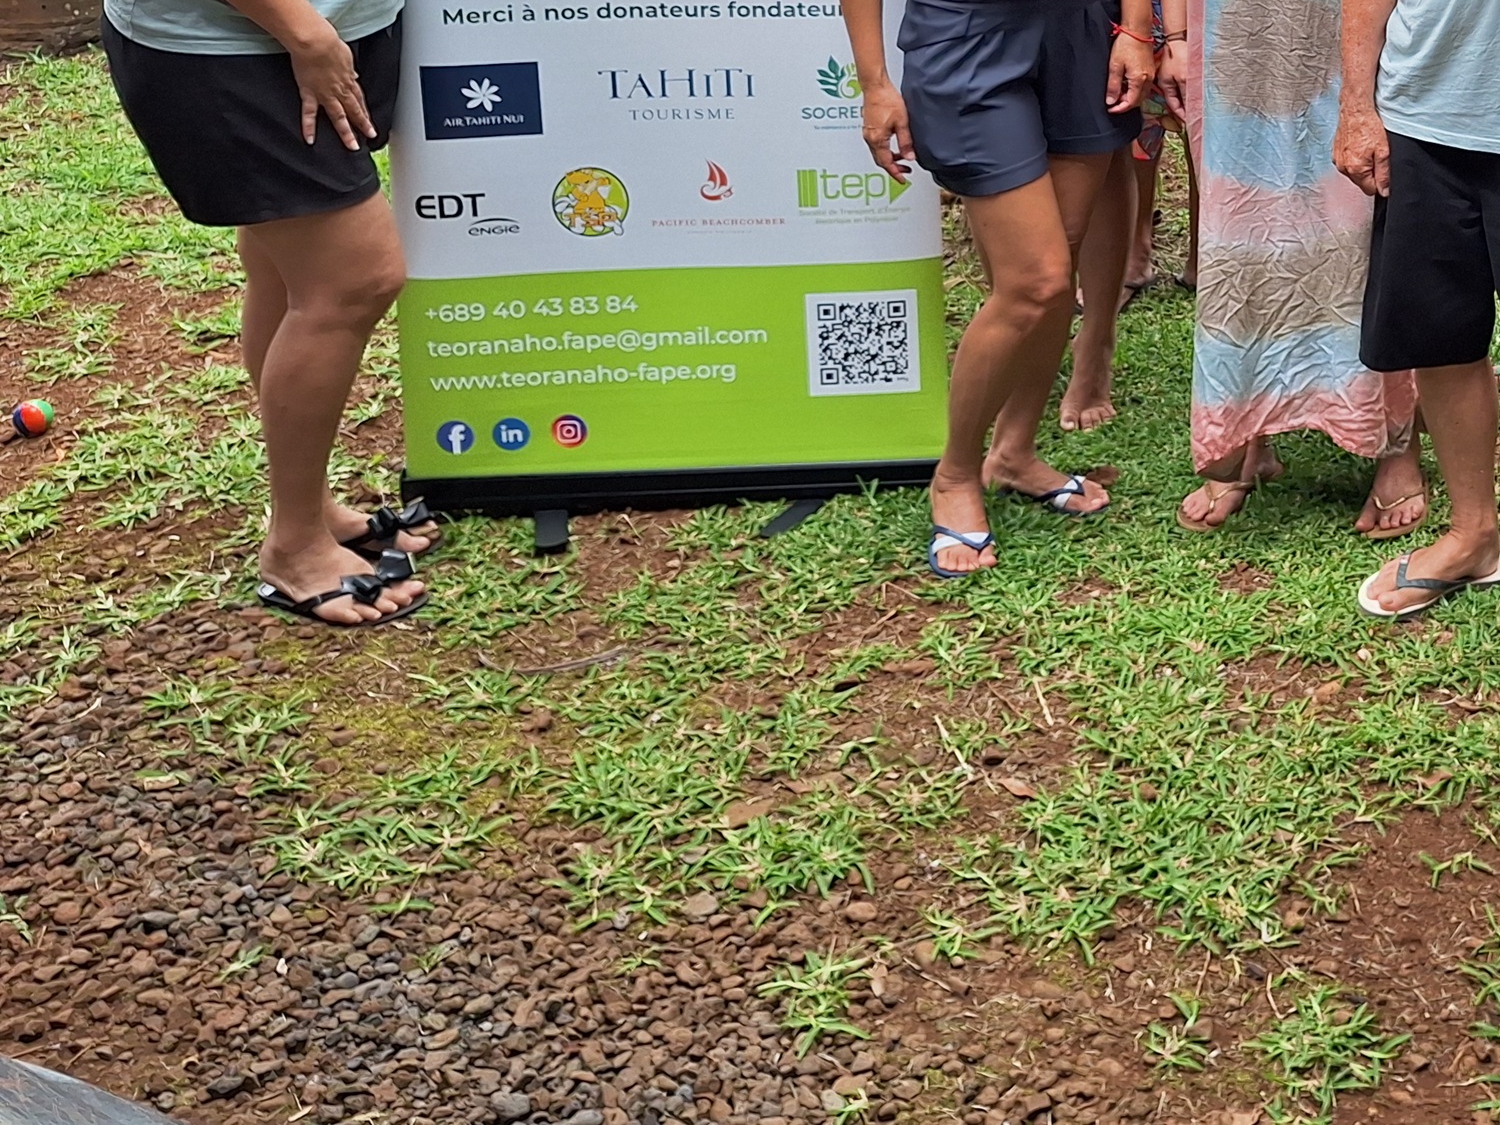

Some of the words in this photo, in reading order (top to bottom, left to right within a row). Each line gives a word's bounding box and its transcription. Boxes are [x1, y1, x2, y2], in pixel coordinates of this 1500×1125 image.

[442, 3, 514, 25] Merci
[521, 3, 536, 21] à
[544, 6, 589, 21] nos
[596, 1, 721, 20] donateurs
[597, 68, 756, 99] TAHITI
[443, 116, 464, 127] AIR
[464, 115, 501, 126] TAHITI
[503, 114, 525, 123] NUI
[628, 108, 736, 121] TOURISME
[415, 193, 486, 220] EDT
[651, 219, 698, 227] PACIFIC
[701, 218, 786, 226] BEACHCOMBER
[425, 302, 486, 323] +689
[492, 300, 526, 319] 40
[532, 297, 564, 316] 43
[569, 295, 600, 315] 83
[605, 295, 639, 314] 84
[426, 326, 768, 358] teoranaho.fape@gmail.com
[430, 362, 737, 392] www.teoranaho-fape.org
